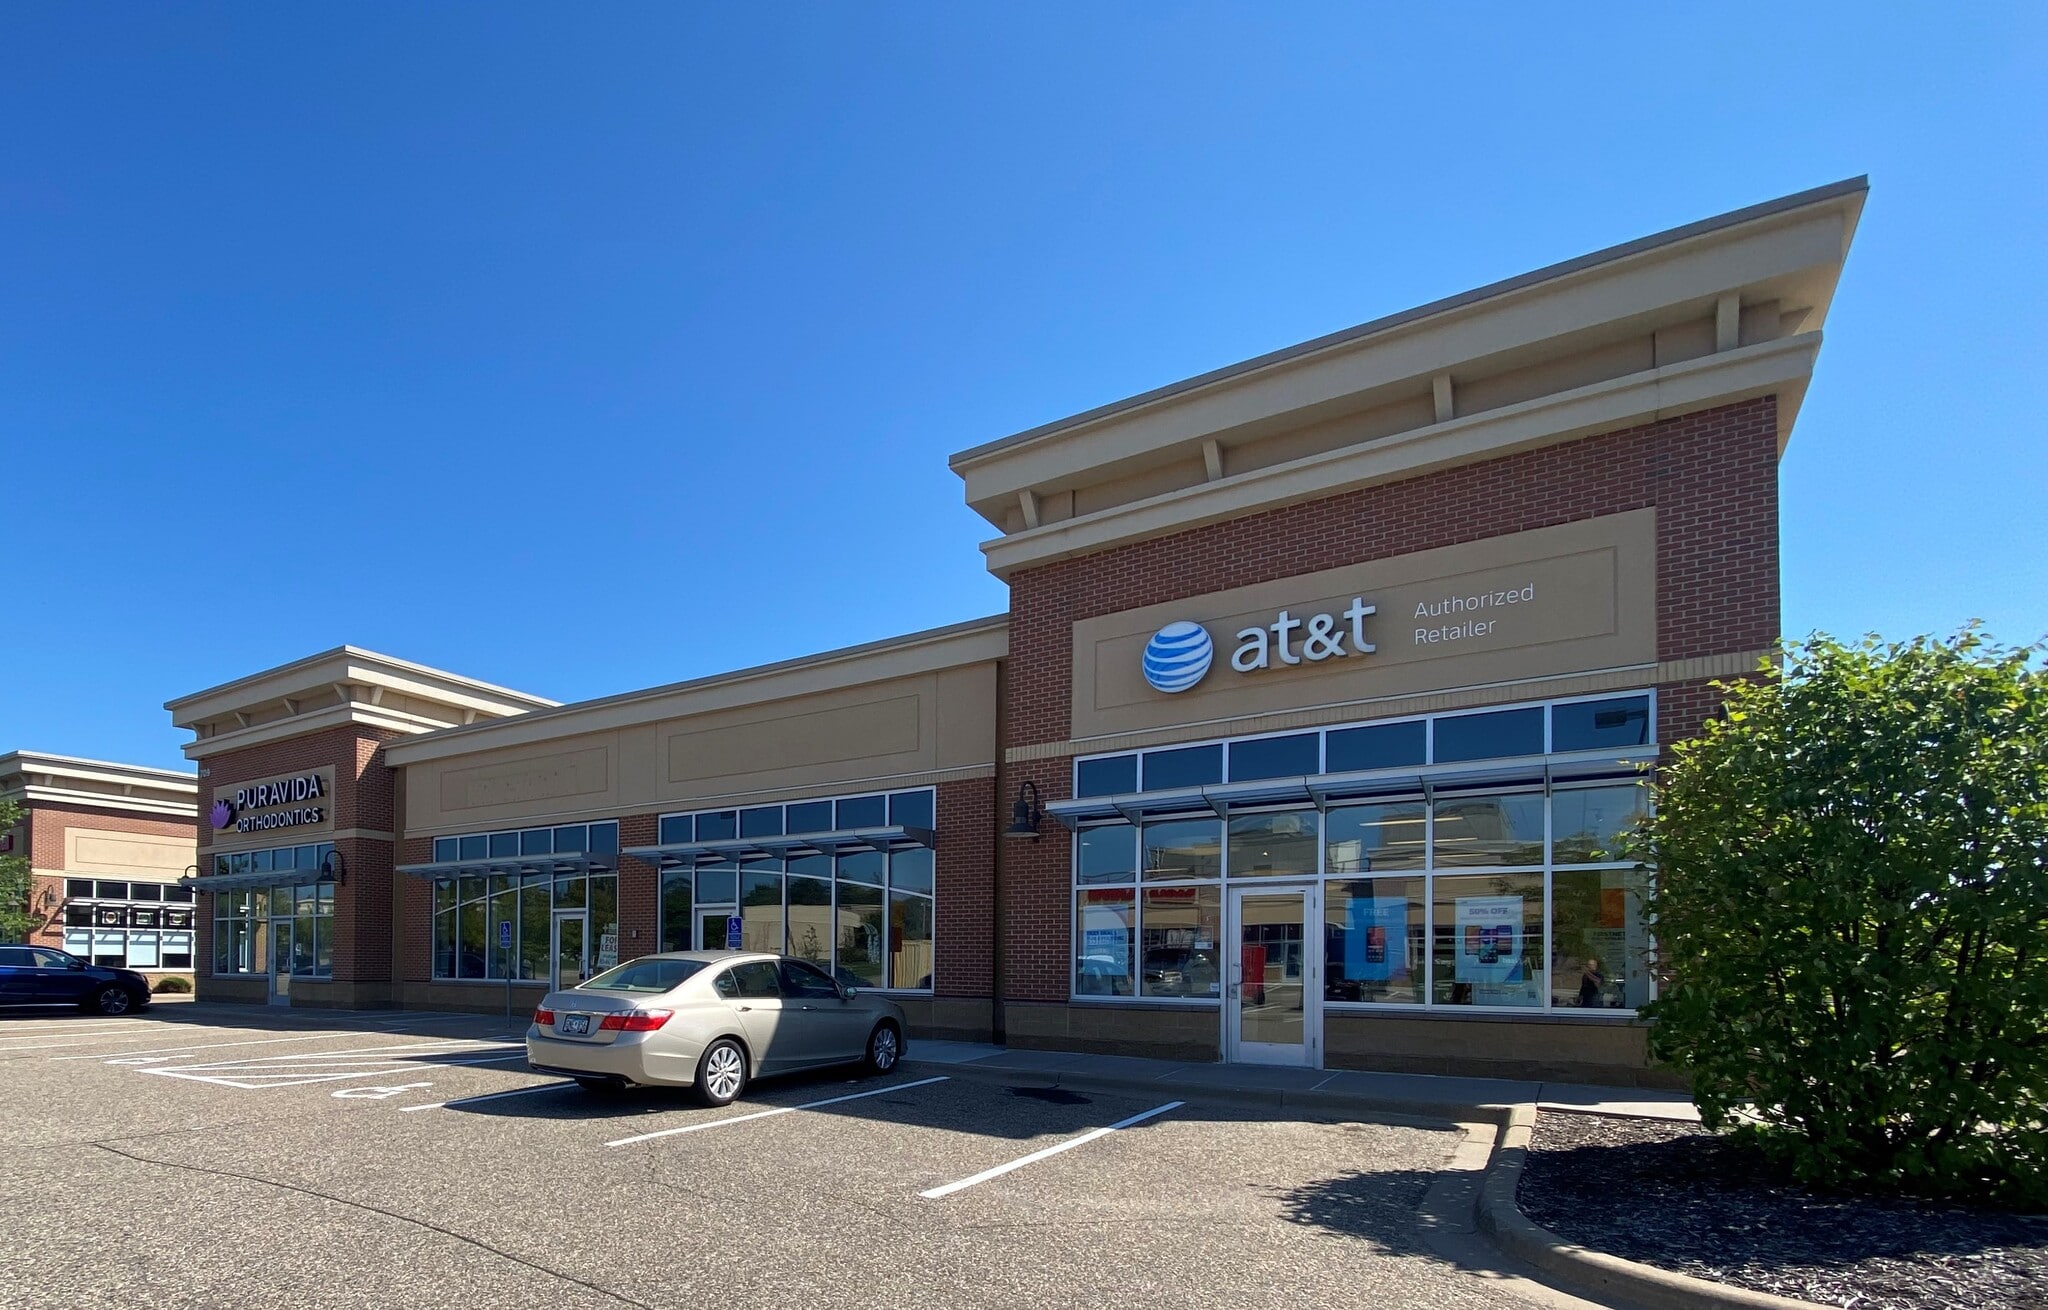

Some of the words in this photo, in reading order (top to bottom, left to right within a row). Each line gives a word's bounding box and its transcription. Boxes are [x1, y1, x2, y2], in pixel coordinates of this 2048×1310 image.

[1414, 582, 1534, 619] Authorized
[1231, 596, 1376, 673] at&t
[1415, 620, 1497, 645] Retailer
[236, 807, 319, 833] ORTHODONTICS
[601, 944, 617, 952] LEAS
